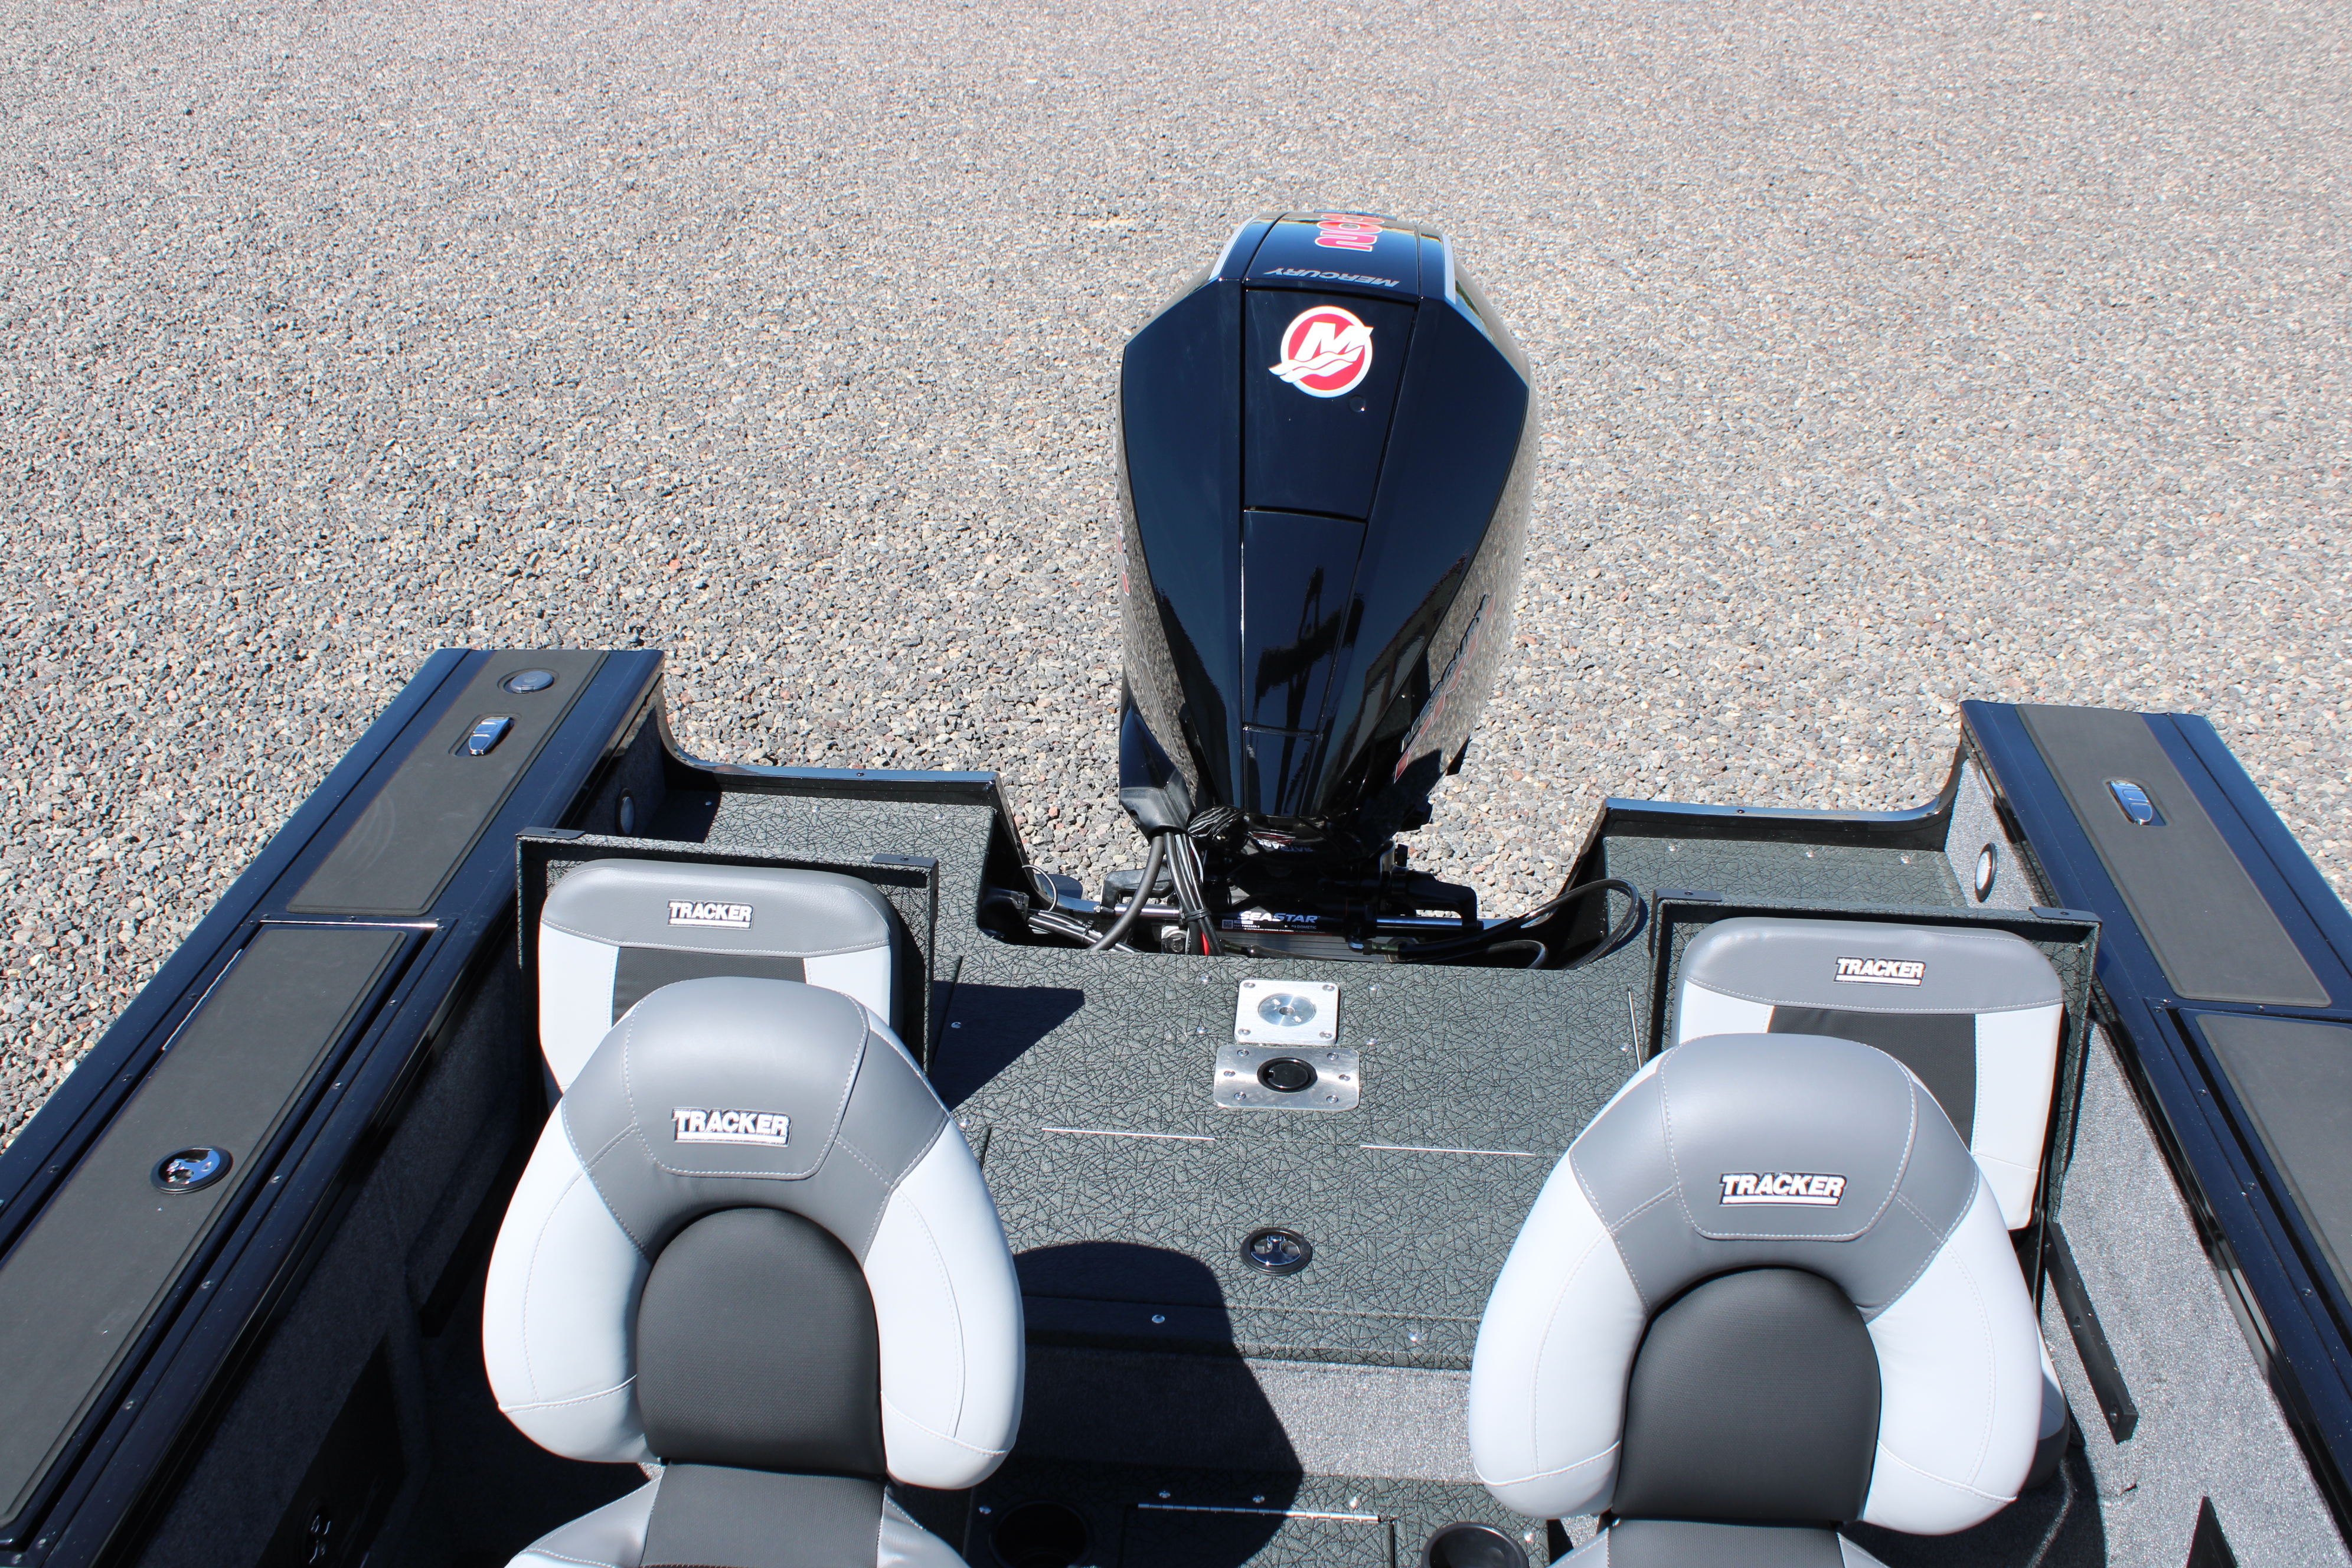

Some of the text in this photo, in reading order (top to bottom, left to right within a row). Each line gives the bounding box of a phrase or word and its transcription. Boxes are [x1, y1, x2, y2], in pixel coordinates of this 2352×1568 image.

[1263, 267, 1400, 288] MERCURY
[1400, 593, 1488, 754] MERCURY
[668, 900, 753, 923] TRACKER
[1836, 957, 1926, 979] TRACKER
[673, 1109, 790, 1136] TRACKER
[1720, 1173, 1847, 1197] TRACKER
